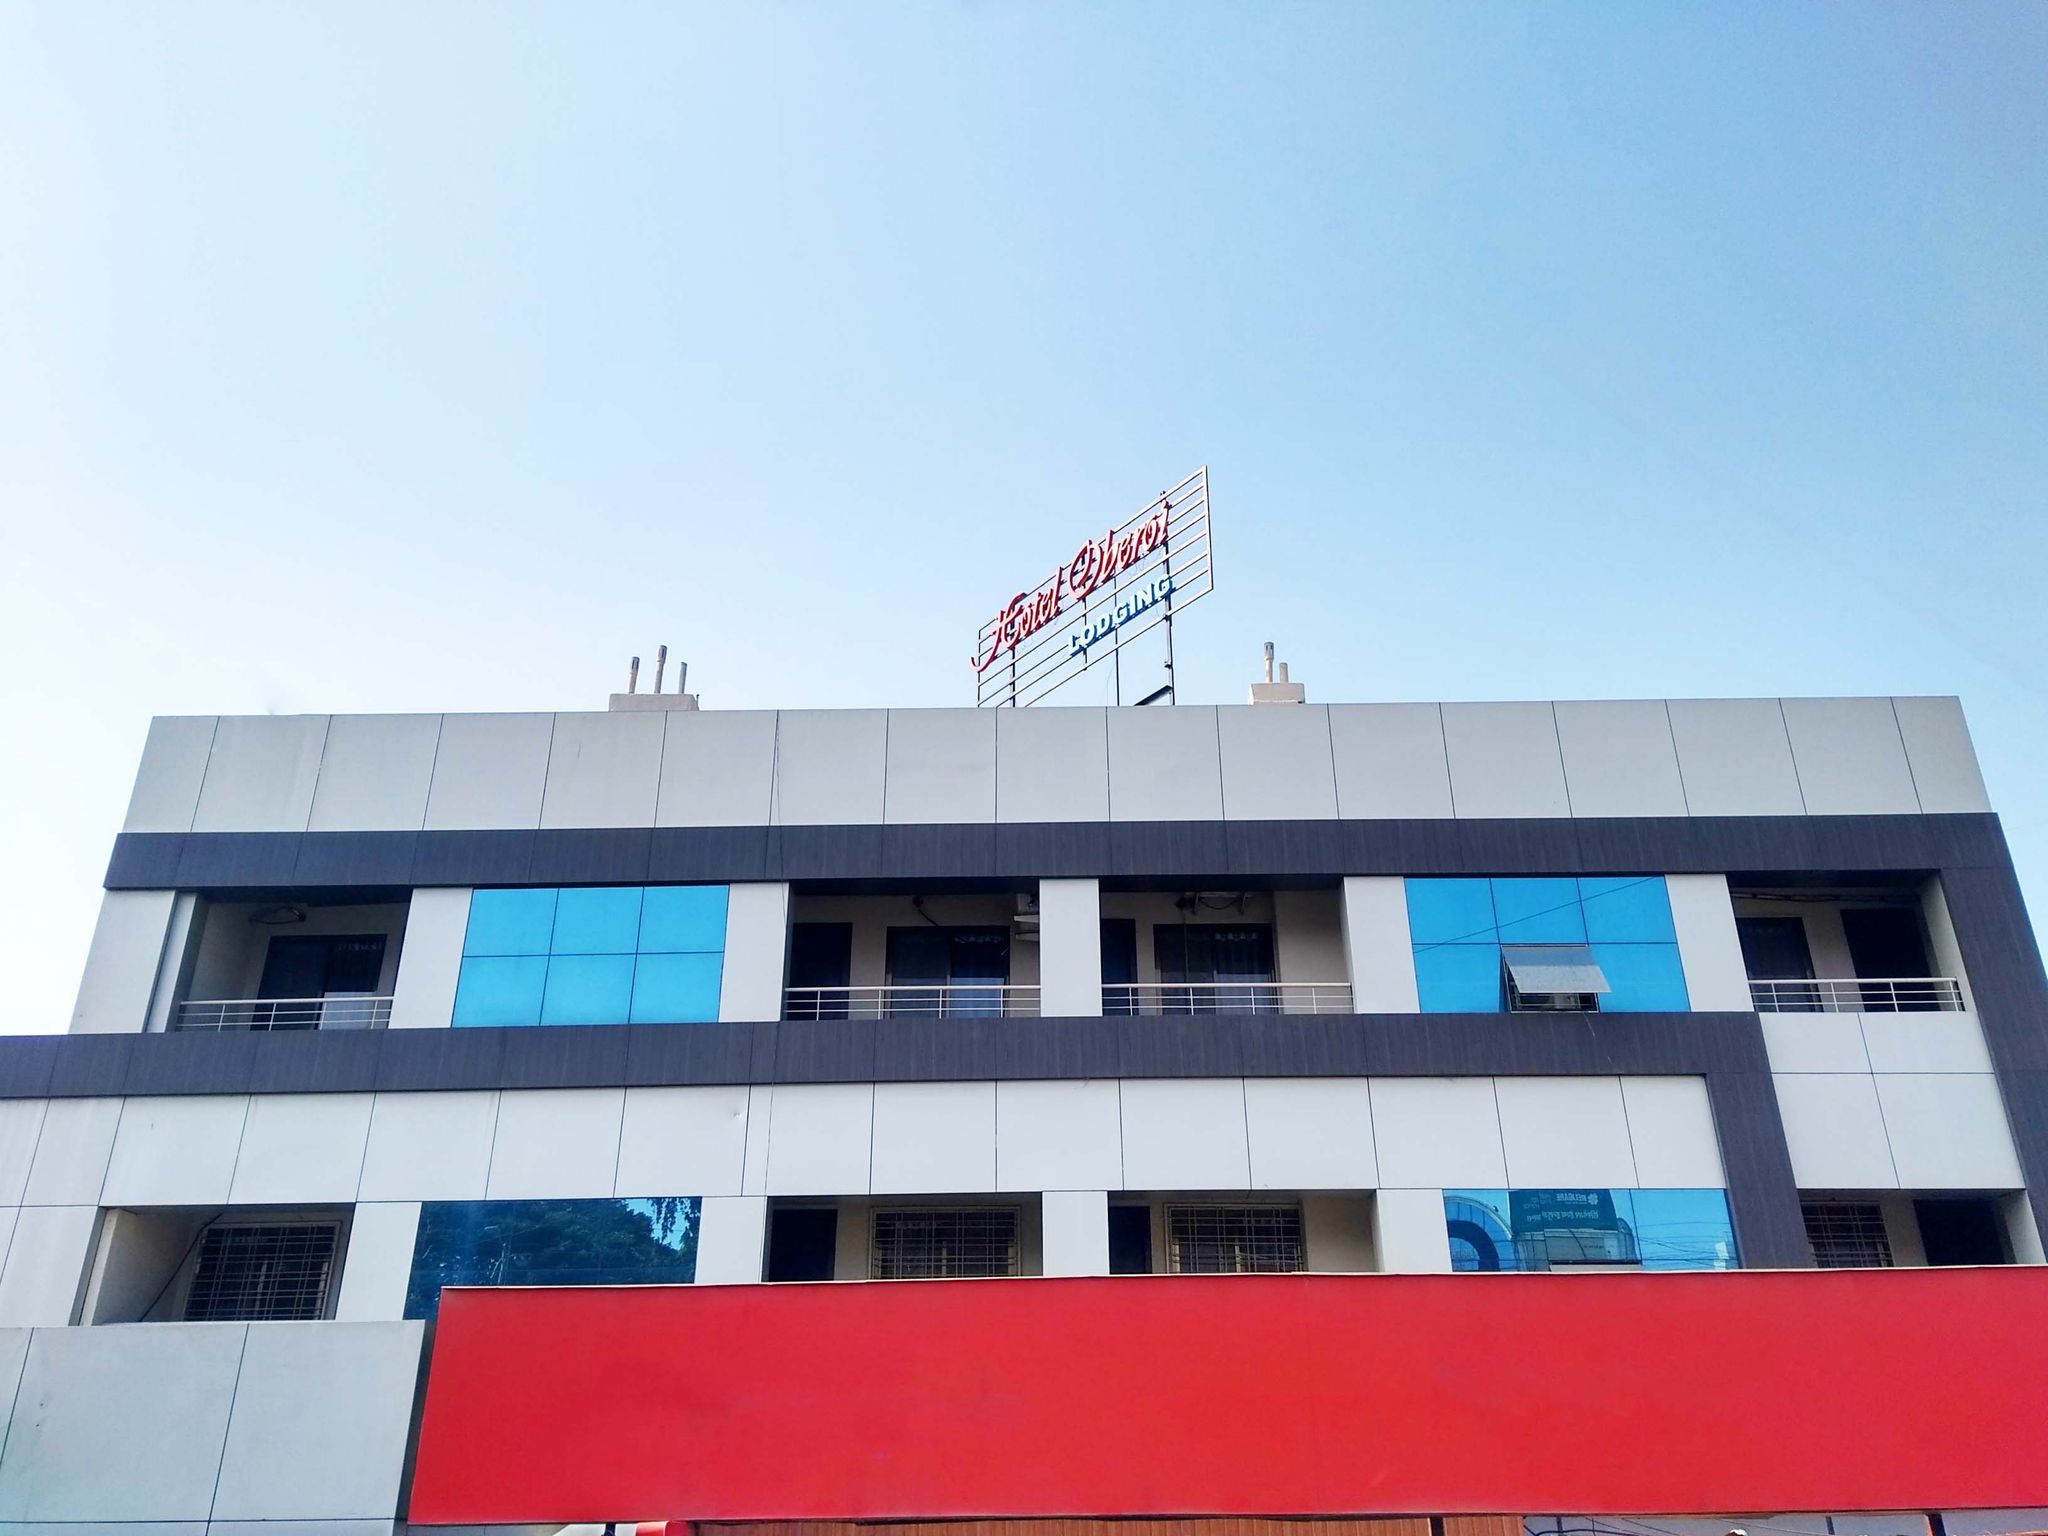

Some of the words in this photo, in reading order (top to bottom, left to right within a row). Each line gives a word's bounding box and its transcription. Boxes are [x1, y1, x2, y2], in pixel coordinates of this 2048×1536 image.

[970, 566, 1063, 672] Hotel
[1070, 499, 1171, 601] Oberoi
[1069, 575, 1176, 656] LODGING
